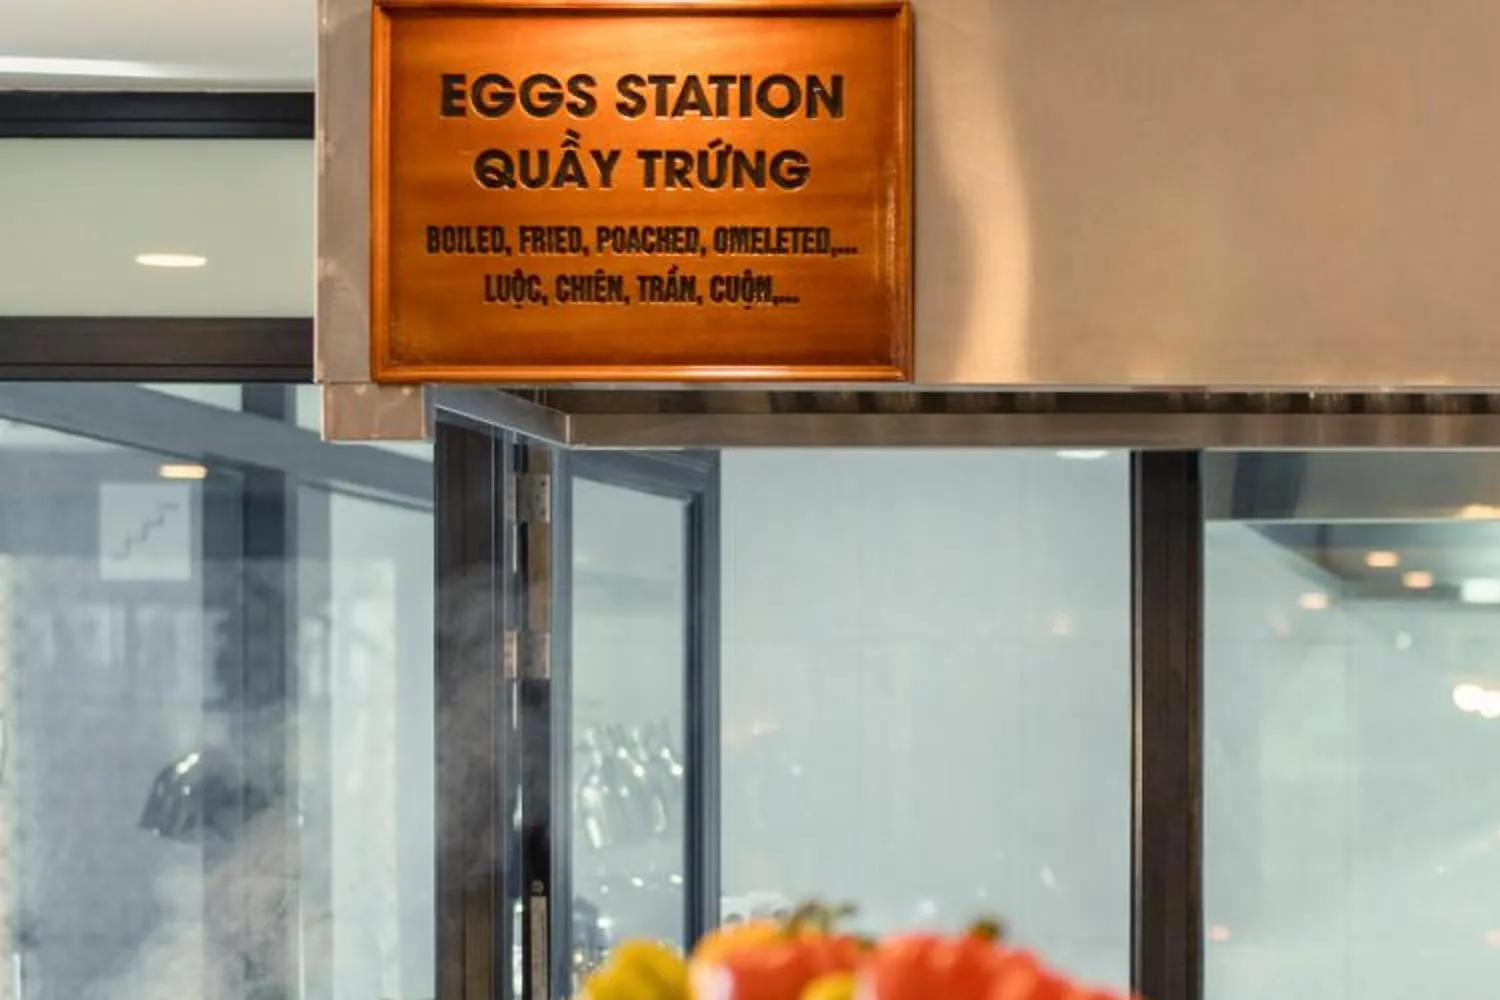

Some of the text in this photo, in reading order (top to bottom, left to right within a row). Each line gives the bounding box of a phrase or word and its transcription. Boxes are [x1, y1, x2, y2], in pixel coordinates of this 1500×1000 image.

[440, 73, 845, 118] EGGS STATION
[473, 129, 811, 190] QUẦY TRỨNG
[426, 225, 512, 257] BOILED,
[518, 225, 590, 257] FRIED,
[596, 226, 707, 257] POACHED,
[484, 268, 549, 310] LUỘC,
[555, 268, 630, 306] CHIÊN,
